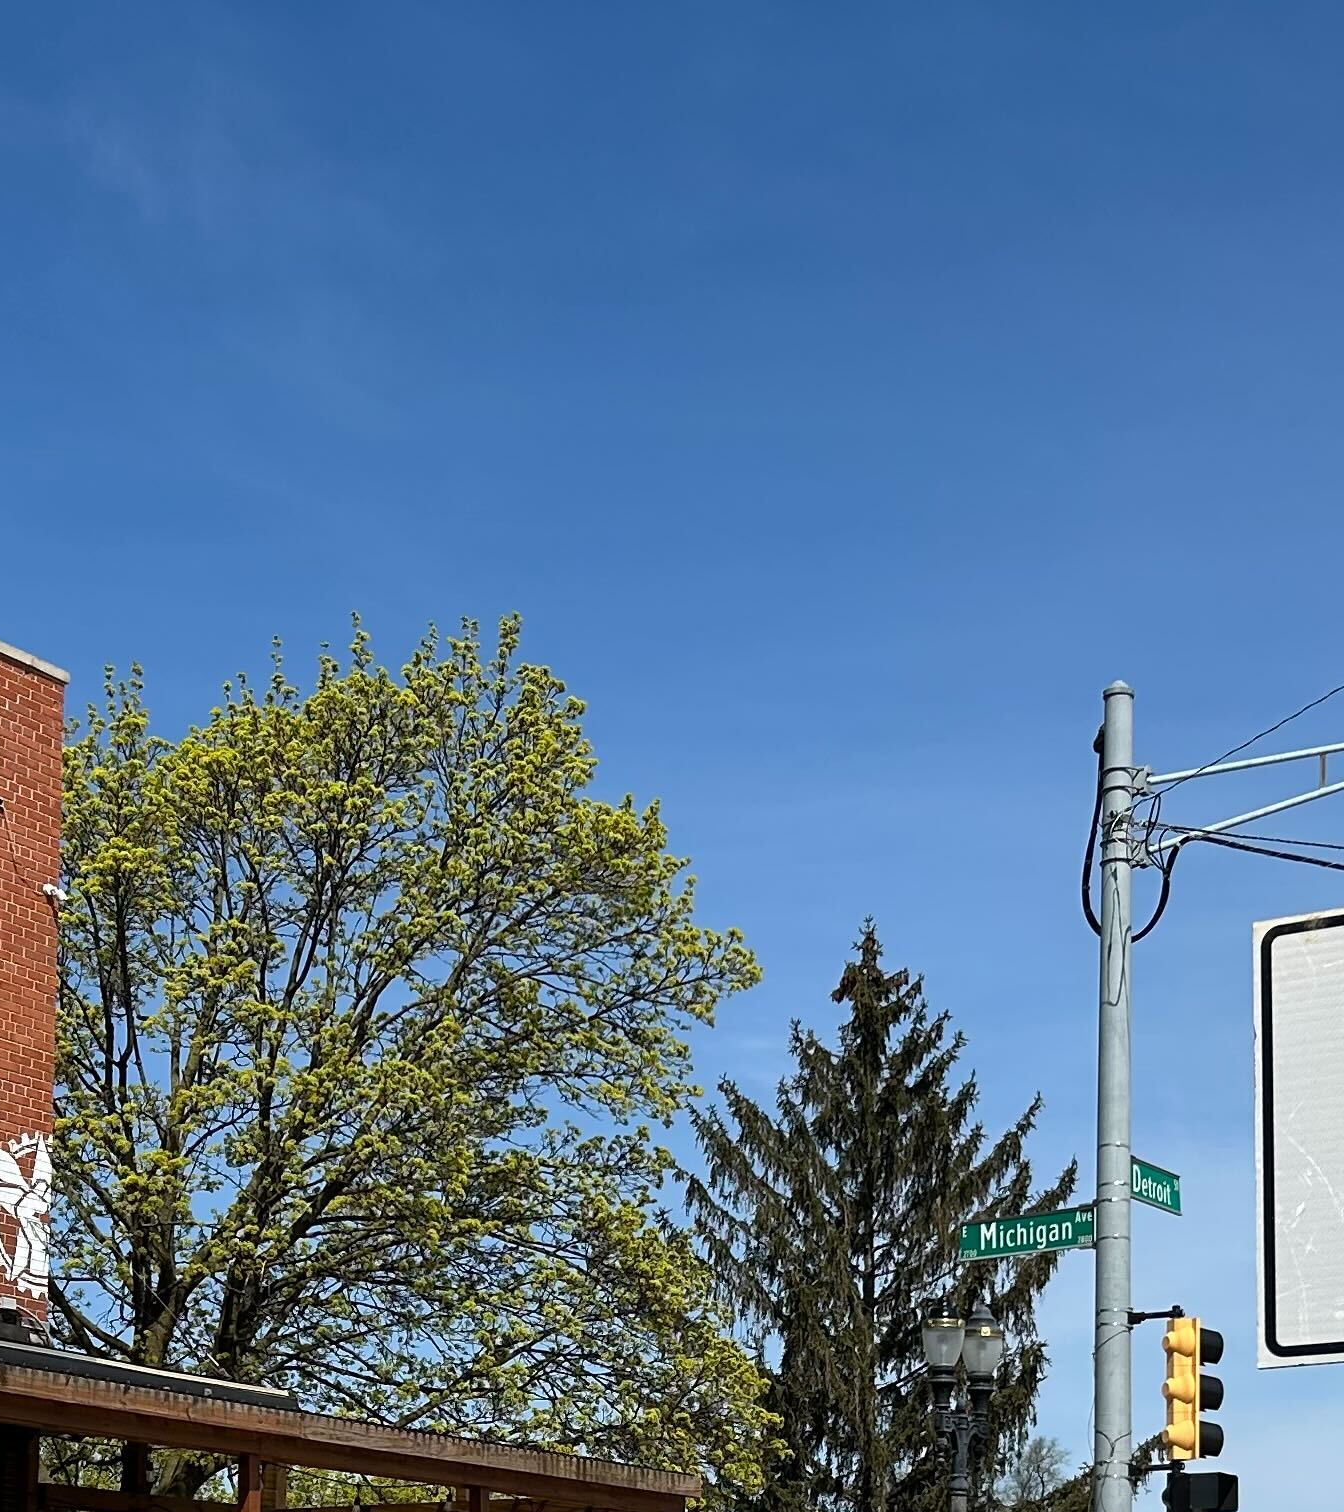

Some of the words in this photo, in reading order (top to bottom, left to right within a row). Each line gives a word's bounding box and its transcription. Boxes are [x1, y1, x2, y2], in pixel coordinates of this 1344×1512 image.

[1132, 1164, 1172, 1206] Detroit
[962, 1225, 968, 1239] E
[980, 1221, 1072, 1250] Michigan
[1074, 1210, 1093, 1224] Ave
